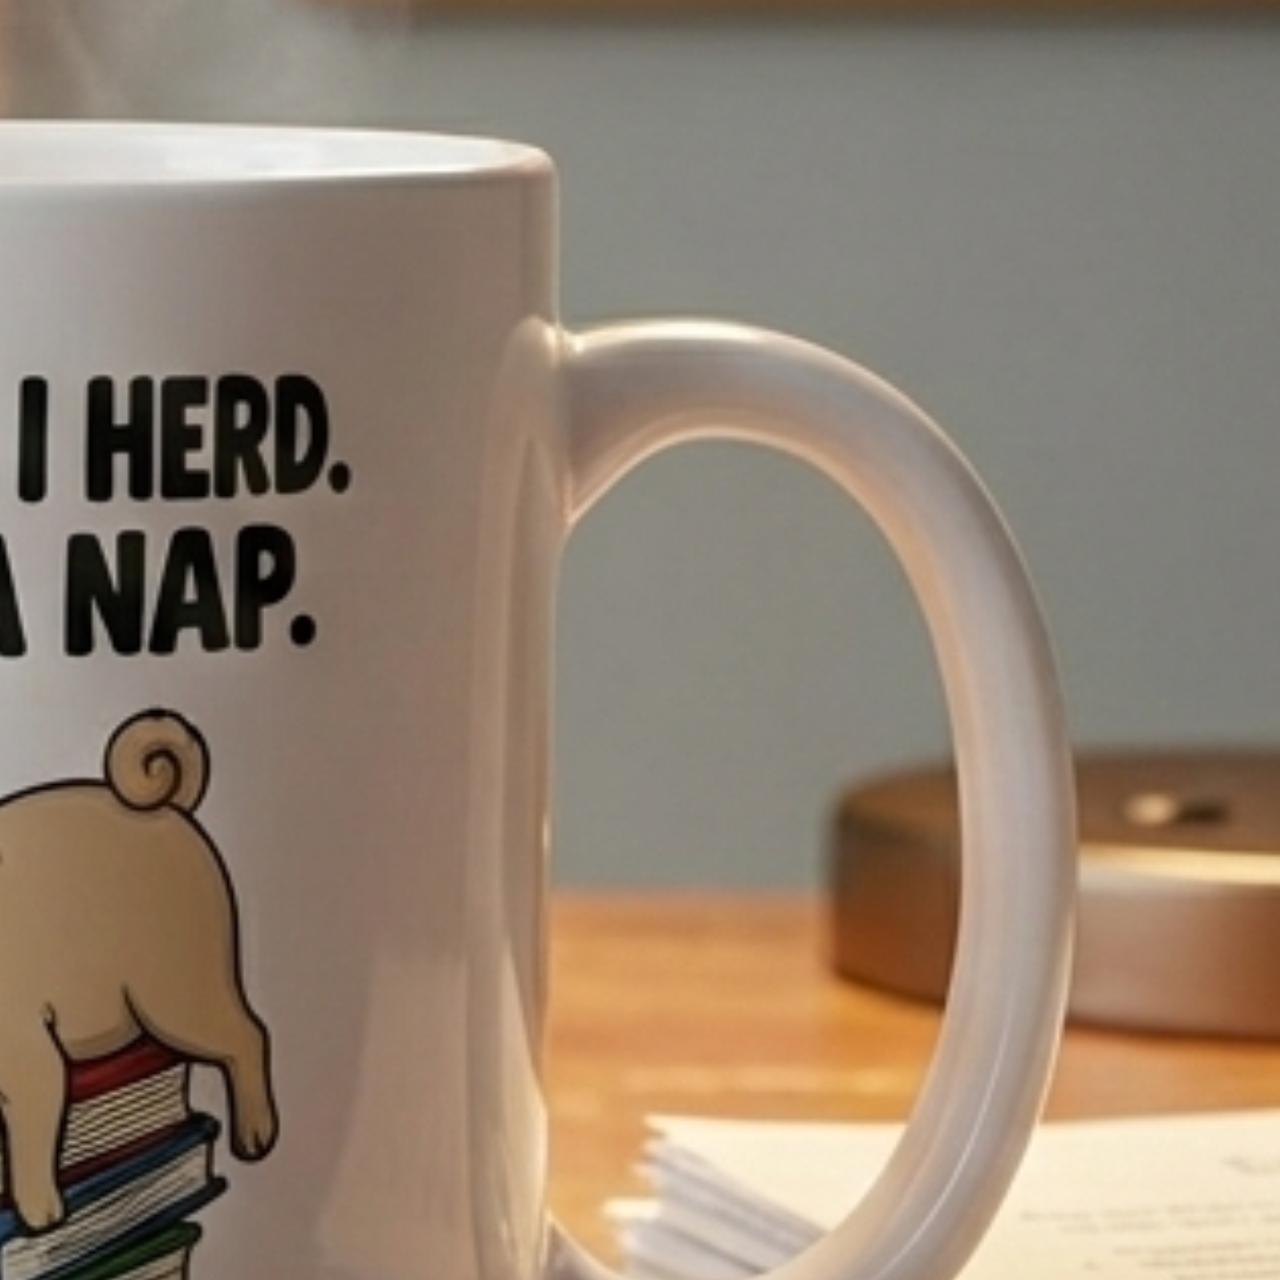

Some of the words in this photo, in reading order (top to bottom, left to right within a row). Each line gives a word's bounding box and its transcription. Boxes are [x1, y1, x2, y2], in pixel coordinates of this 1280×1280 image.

[17, 375, 49, 503] I
[85, 373, 353, 503] HERD.
[64, 523, 318, 658] NAP.
